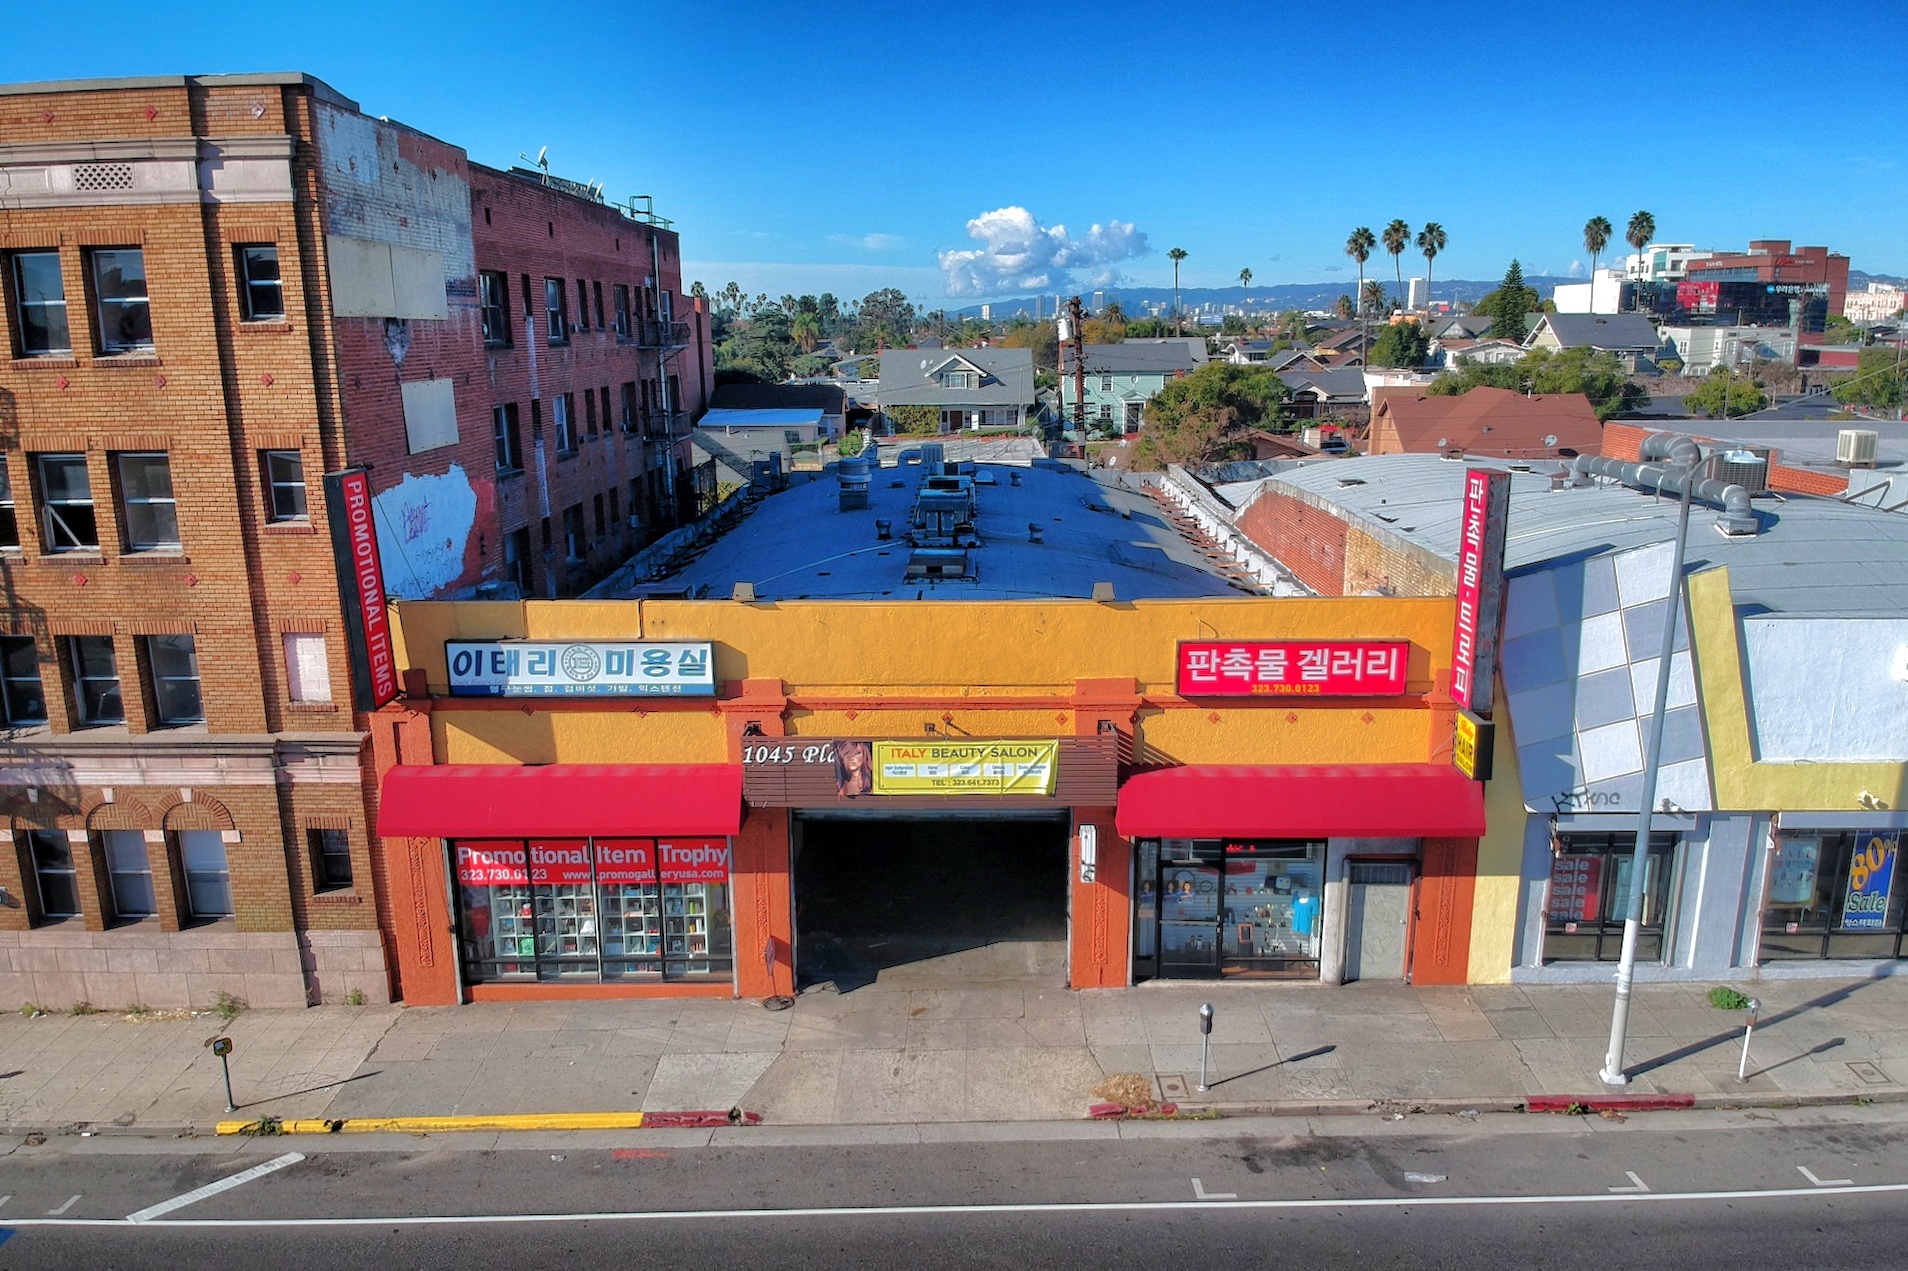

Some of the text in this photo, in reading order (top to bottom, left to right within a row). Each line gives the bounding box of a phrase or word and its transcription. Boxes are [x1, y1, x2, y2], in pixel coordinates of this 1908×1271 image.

[347, 480, 393, 698] PROMOTIONAL ITEMS
[453, 649, 556, 677] 이태리
[605, 648, 708, 677] 미용실
[1186, 647, 1398, 681] 판촉물 겔러리
[1251, 683, 1320, 693] 323.730.0123
[742, 745, 795, 763] 1045
[891, 747, 1038, 759] ITALY BEAUTY SALON
[457, 843, 728, 867] Promotional Item Trophy
[1555, 858, 1590, 871] sale
[461, 868, 724, 881] 323.730.0123 www.promogalleryusa.com
[1554, 871, 1589, 883] sale
[1553, 883, 1587, 896] sale
[1551, 896, 1585, 908] sale
[1846, 889, 1887, 913] Sale
[1550, 908, 1584, 920] sale
